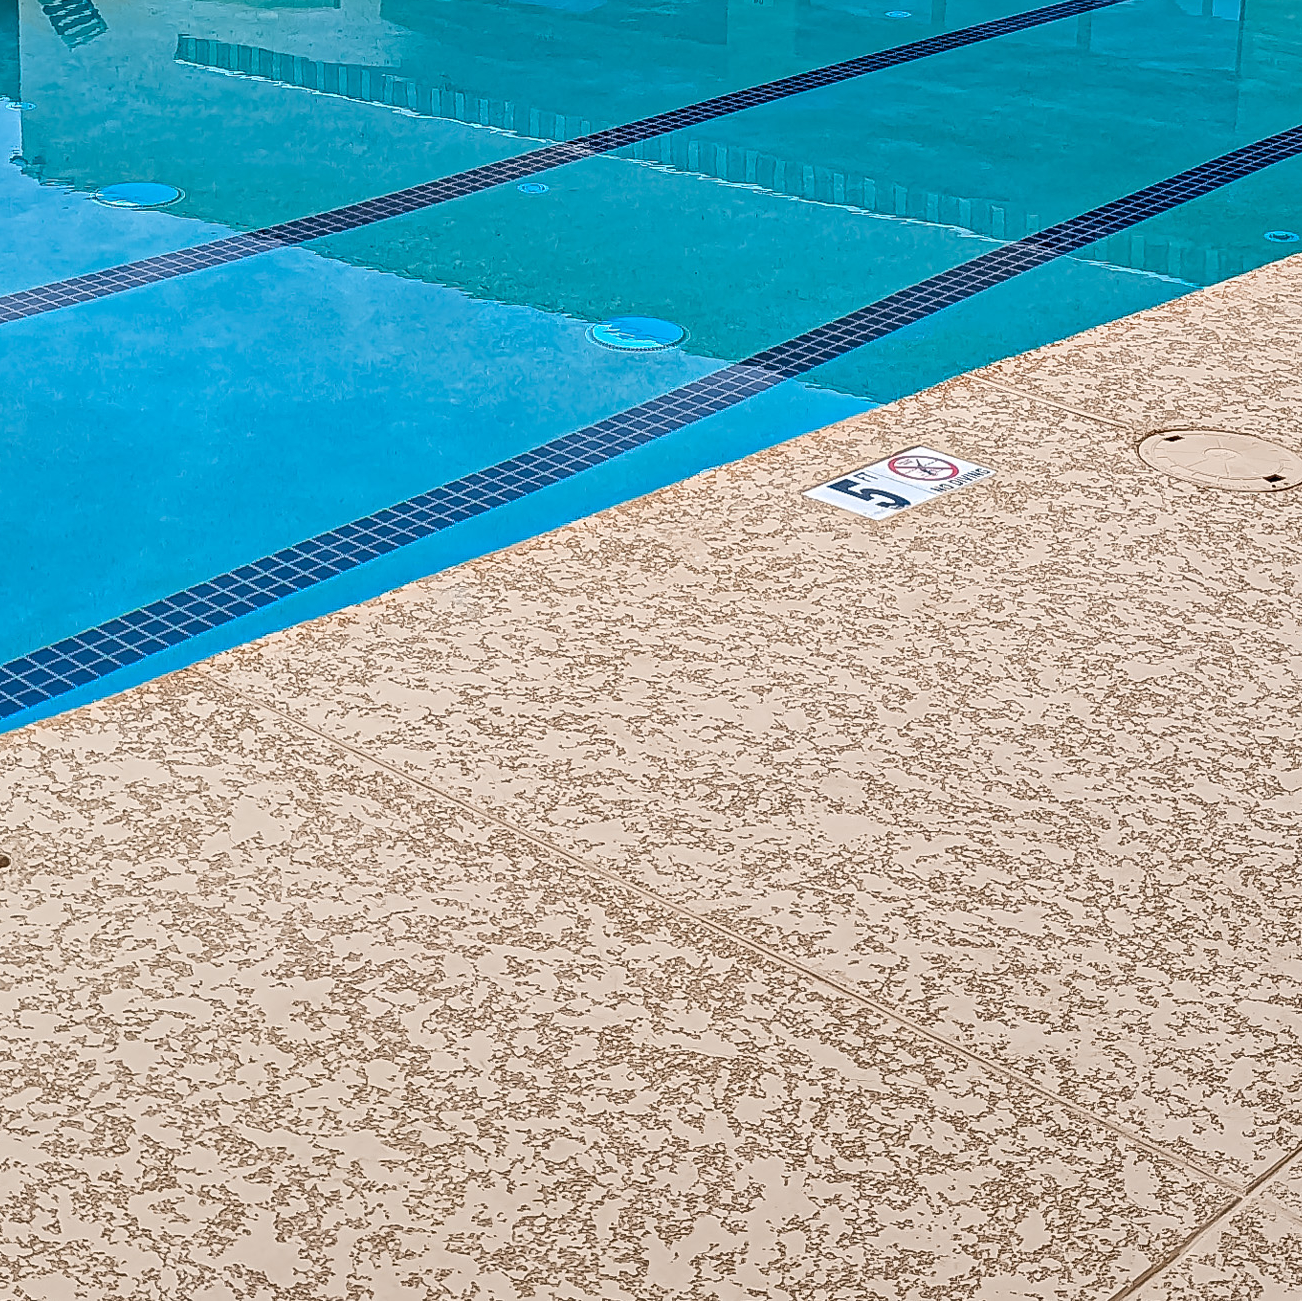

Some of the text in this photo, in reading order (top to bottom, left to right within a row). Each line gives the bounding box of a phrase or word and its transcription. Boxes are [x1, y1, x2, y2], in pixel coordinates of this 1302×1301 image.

[827, 471, 912, 510] 5 FT
[948, 467, 991, 487] DIVING
